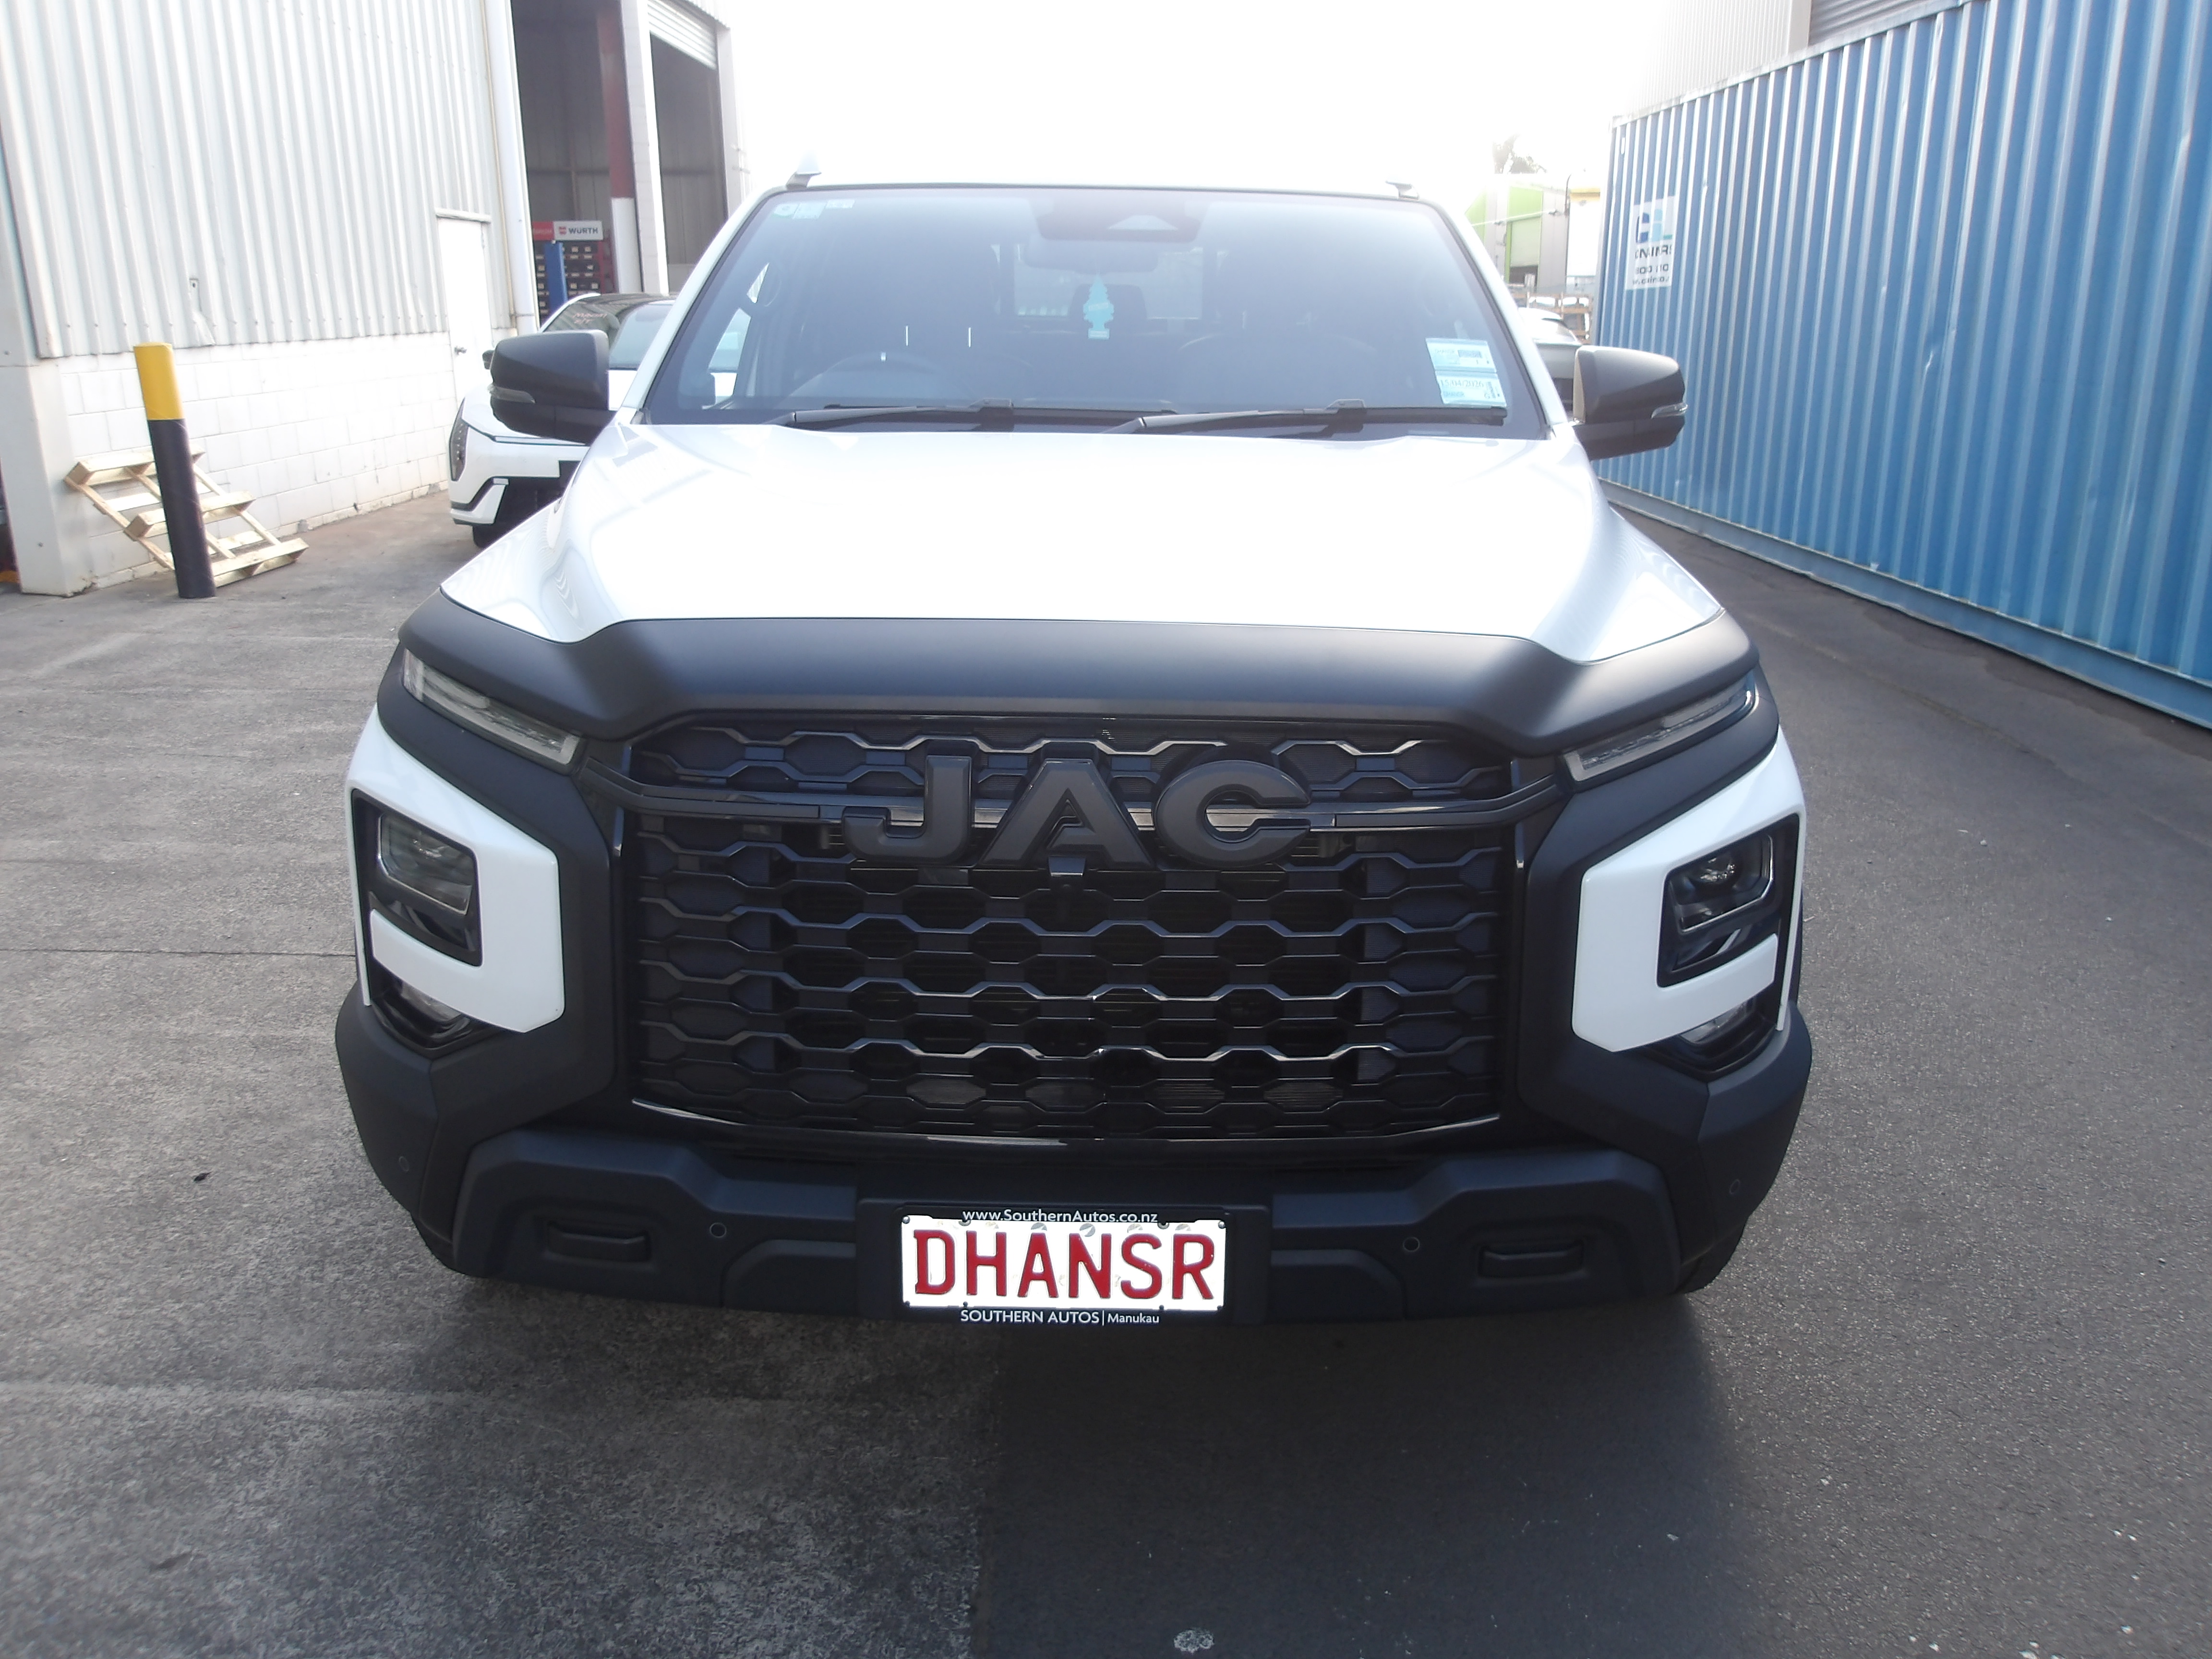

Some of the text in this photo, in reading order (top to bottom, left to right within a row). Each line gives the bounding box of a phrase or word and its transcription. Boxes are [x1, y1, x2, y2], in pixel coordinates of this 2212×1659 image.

[842, 755, 1311, 867] JAC
[963, 1210, 1158, 1222] www.SouthernAutos.co.nz
[913, 1229, 1215, 1300] DHANSR
[961, 1310, 1160, 1324] SOUTHERN AUTOS Manukau
